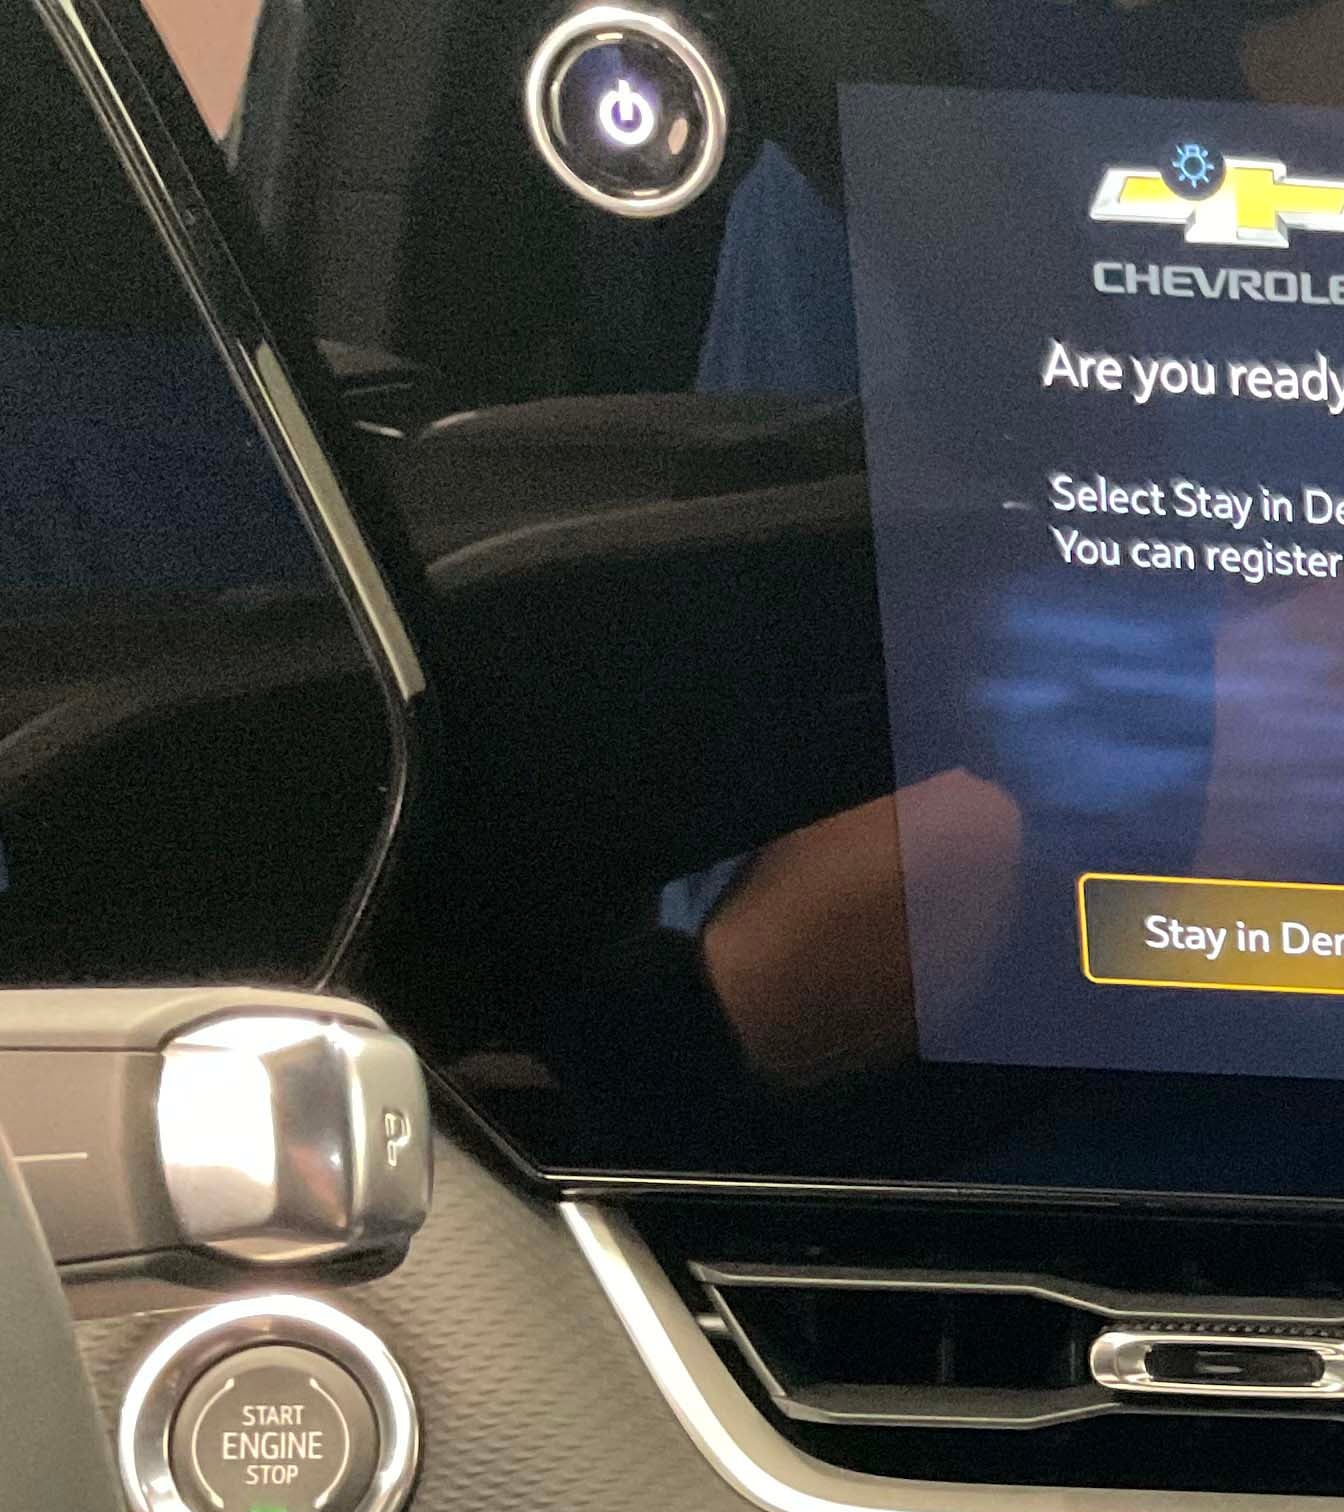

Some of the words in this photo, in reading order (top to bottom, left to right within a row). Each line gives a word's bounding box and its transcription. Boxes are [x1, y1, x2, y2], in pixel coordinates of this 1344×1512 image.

[1043, 341, 1123, 392] Are
[1131, 355, 1216, 404] you
[1051, 473, 1166, 516] Select
[1172, 481, 1252, 530] Stay
[1260, 487, 1294, 522] in
[1051, 526, 1121, 567] You
[1130, 539, 1196, 570] can
[1205, 541, 1344, 584] register
[1144, 914, 1228, 961] Stay
[1236, 921, 1270, 953] in
[242, 1405, 305, 1427] START
[221, 1432, 324, 1460] ENGINE
[245, 1465, 299, 1485] STOP
